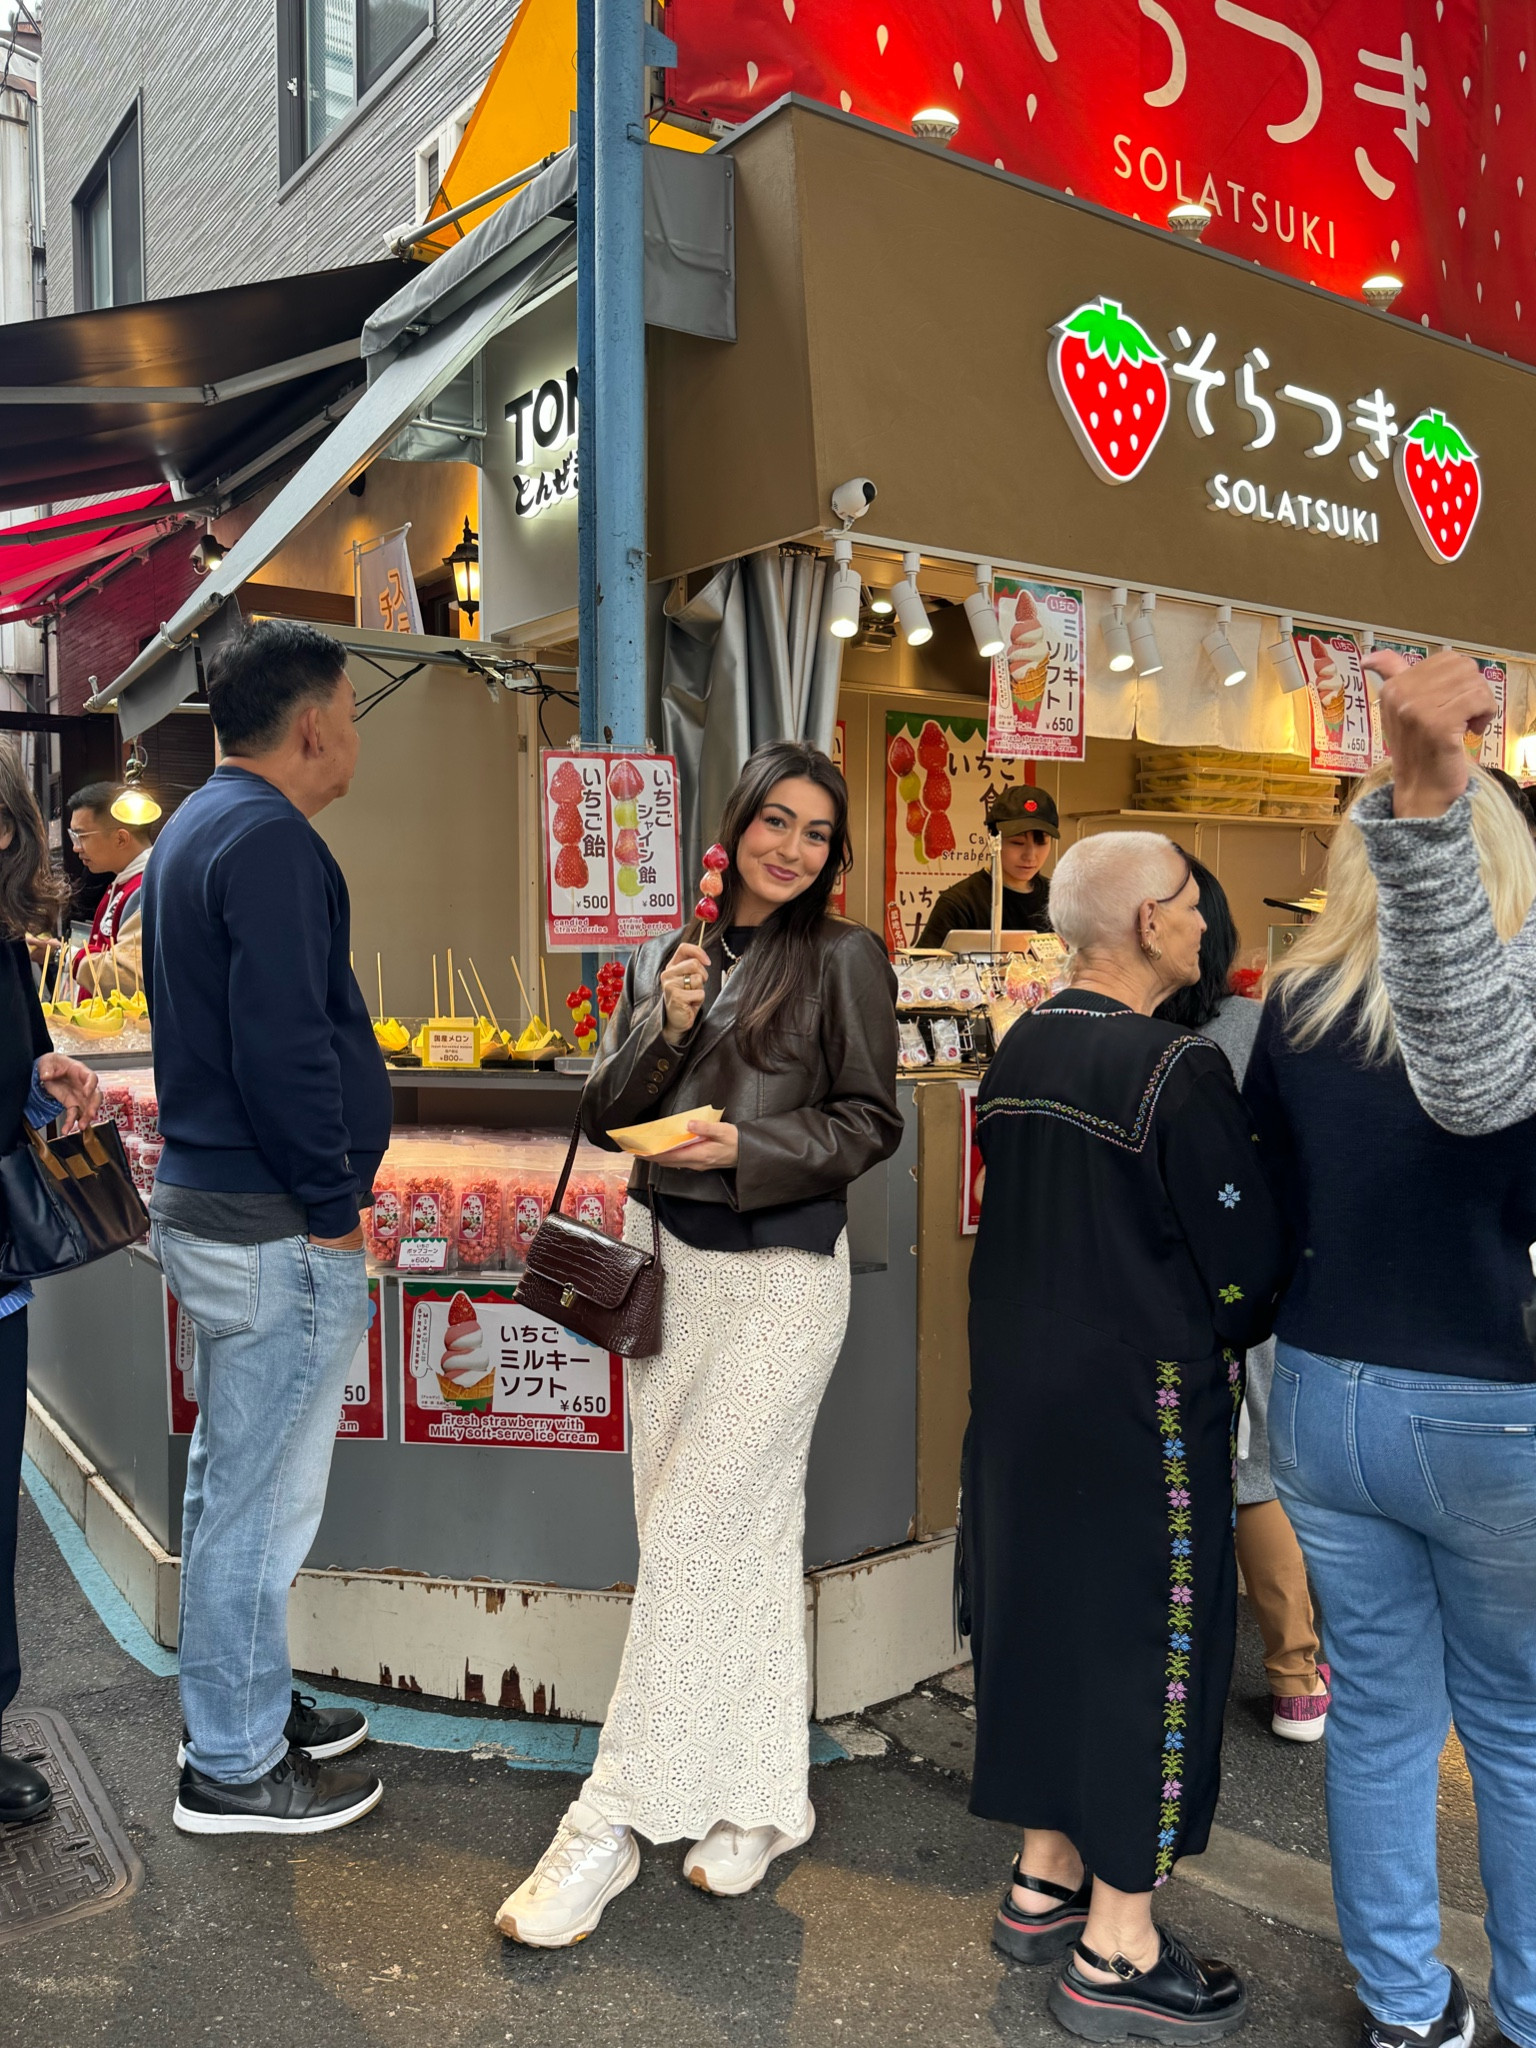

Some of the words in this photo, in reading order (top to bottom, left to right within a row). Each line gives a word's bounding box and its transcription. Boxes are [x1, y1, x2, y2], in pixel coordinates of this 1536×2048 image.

[1113, 134, 1335, 259] SOLATSUKI
[1170, 326, 1399, 480] そらつき
[1209, 473, 1379, 544] SOLATSUKI
[1050, 600, 1076, 613] いちご
[1047, 641, 1060, 710] ソフト
[1063, 619, 1078, 711] ミルキー
[1340, 674, 1355, 732] ソフト
[1348, 656, 1366, 734] ミルキー
[1046, 717, 1074, 732] ¥650
[1347, 738, 1366, 752] ¥650
[653, 769, 673, 828] いちご
[582, 768, 606, 858] いちご飴
[638, 804, 657, 884] シャイン飴
[576, 895, 608, 909] ¥500
[642, 893, 675, 907] ¥800
[900, 886, 946, 909] いち
[554, 918, 589, 927] candied
[554, 925, 608, 934] strawberries
[618, 921, 672, 931] strawberries
[500, 1325, 559, 1344] いちご
[500, 1349, 590, 1371] ミルキー
[500, 1376, 567, 1398] ソフト
[560, 1396, 606, 1414] ¥650
[443, 1415, 478, 1426] Fresh
[482, 1416, 552, 1431] strawberry
[555, 1419, 583, 1430] with
[430, 1426, 464, 1440] Milky
[467, 1427, 531, 1440] soft-serve
[535, 1429, 554, 1441] ice
[557, 1432, 598, 1443] cream
